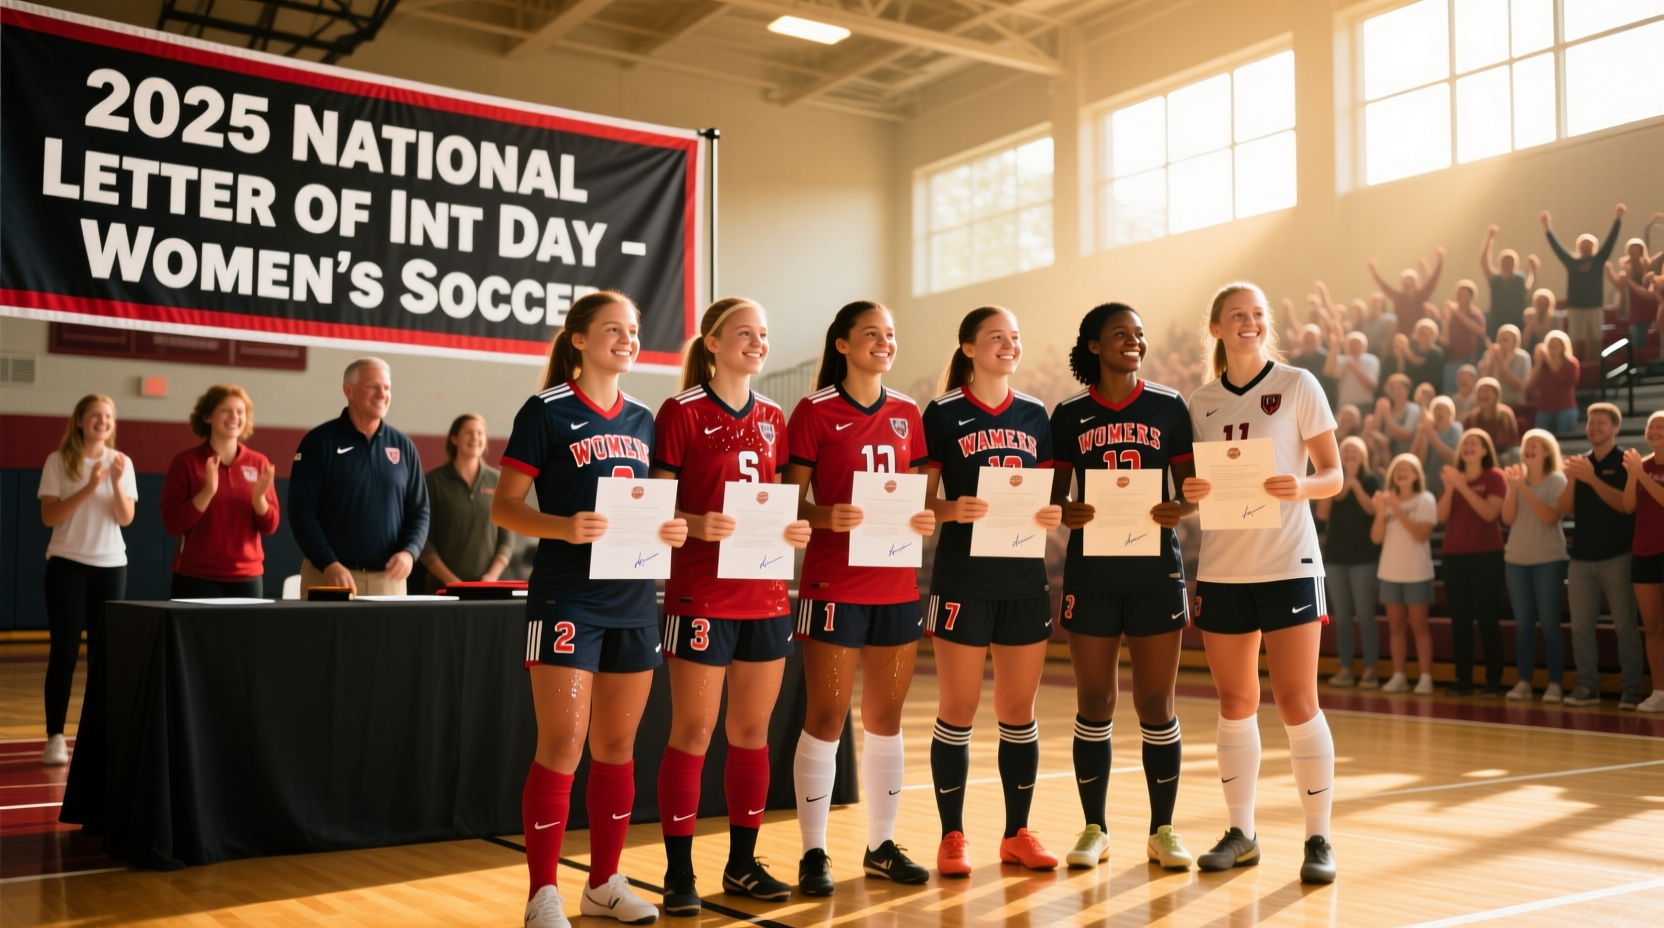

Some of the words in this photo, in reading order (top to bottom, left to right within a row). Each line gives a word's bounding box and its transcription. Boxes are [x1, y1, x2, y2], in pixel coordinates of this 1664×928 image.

[86, 69, 270, 154] 2025
[293, 104, 588, 203] NATIONAL
[43, 137, 276, 227] LETTER
[295, 184, 372, 238] OF
[390, 190, 483, 252] INT
[499, 205, 607, 267] DAY
[80, 219, 384, 309] WOMEN'S
[824, 602, 836, 631] 1
[944, 602, 961, 631] 7
[554, 621, 575, 654] 2
[690, 618, 710, 651] 3
